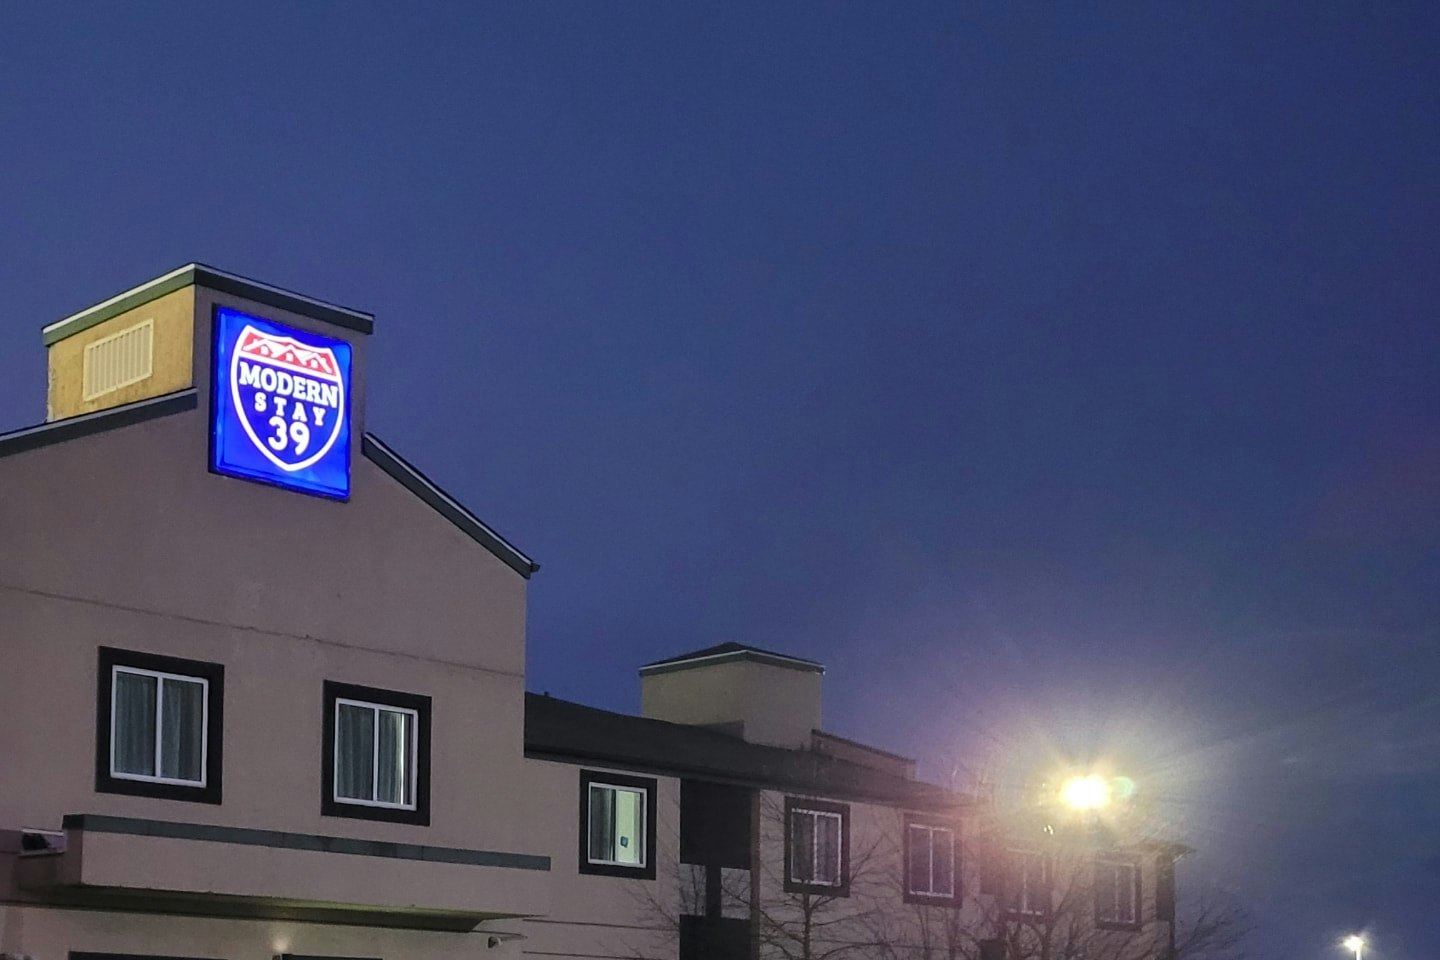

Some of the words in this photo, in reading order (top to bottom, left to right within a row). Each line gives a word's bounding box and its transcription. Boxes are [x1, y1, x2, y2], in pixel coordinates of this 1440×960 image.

[239, 361, 338, 408] MODERN
[254, 392, 326, 426] STAY
[268, 416, 310, 456] 39
